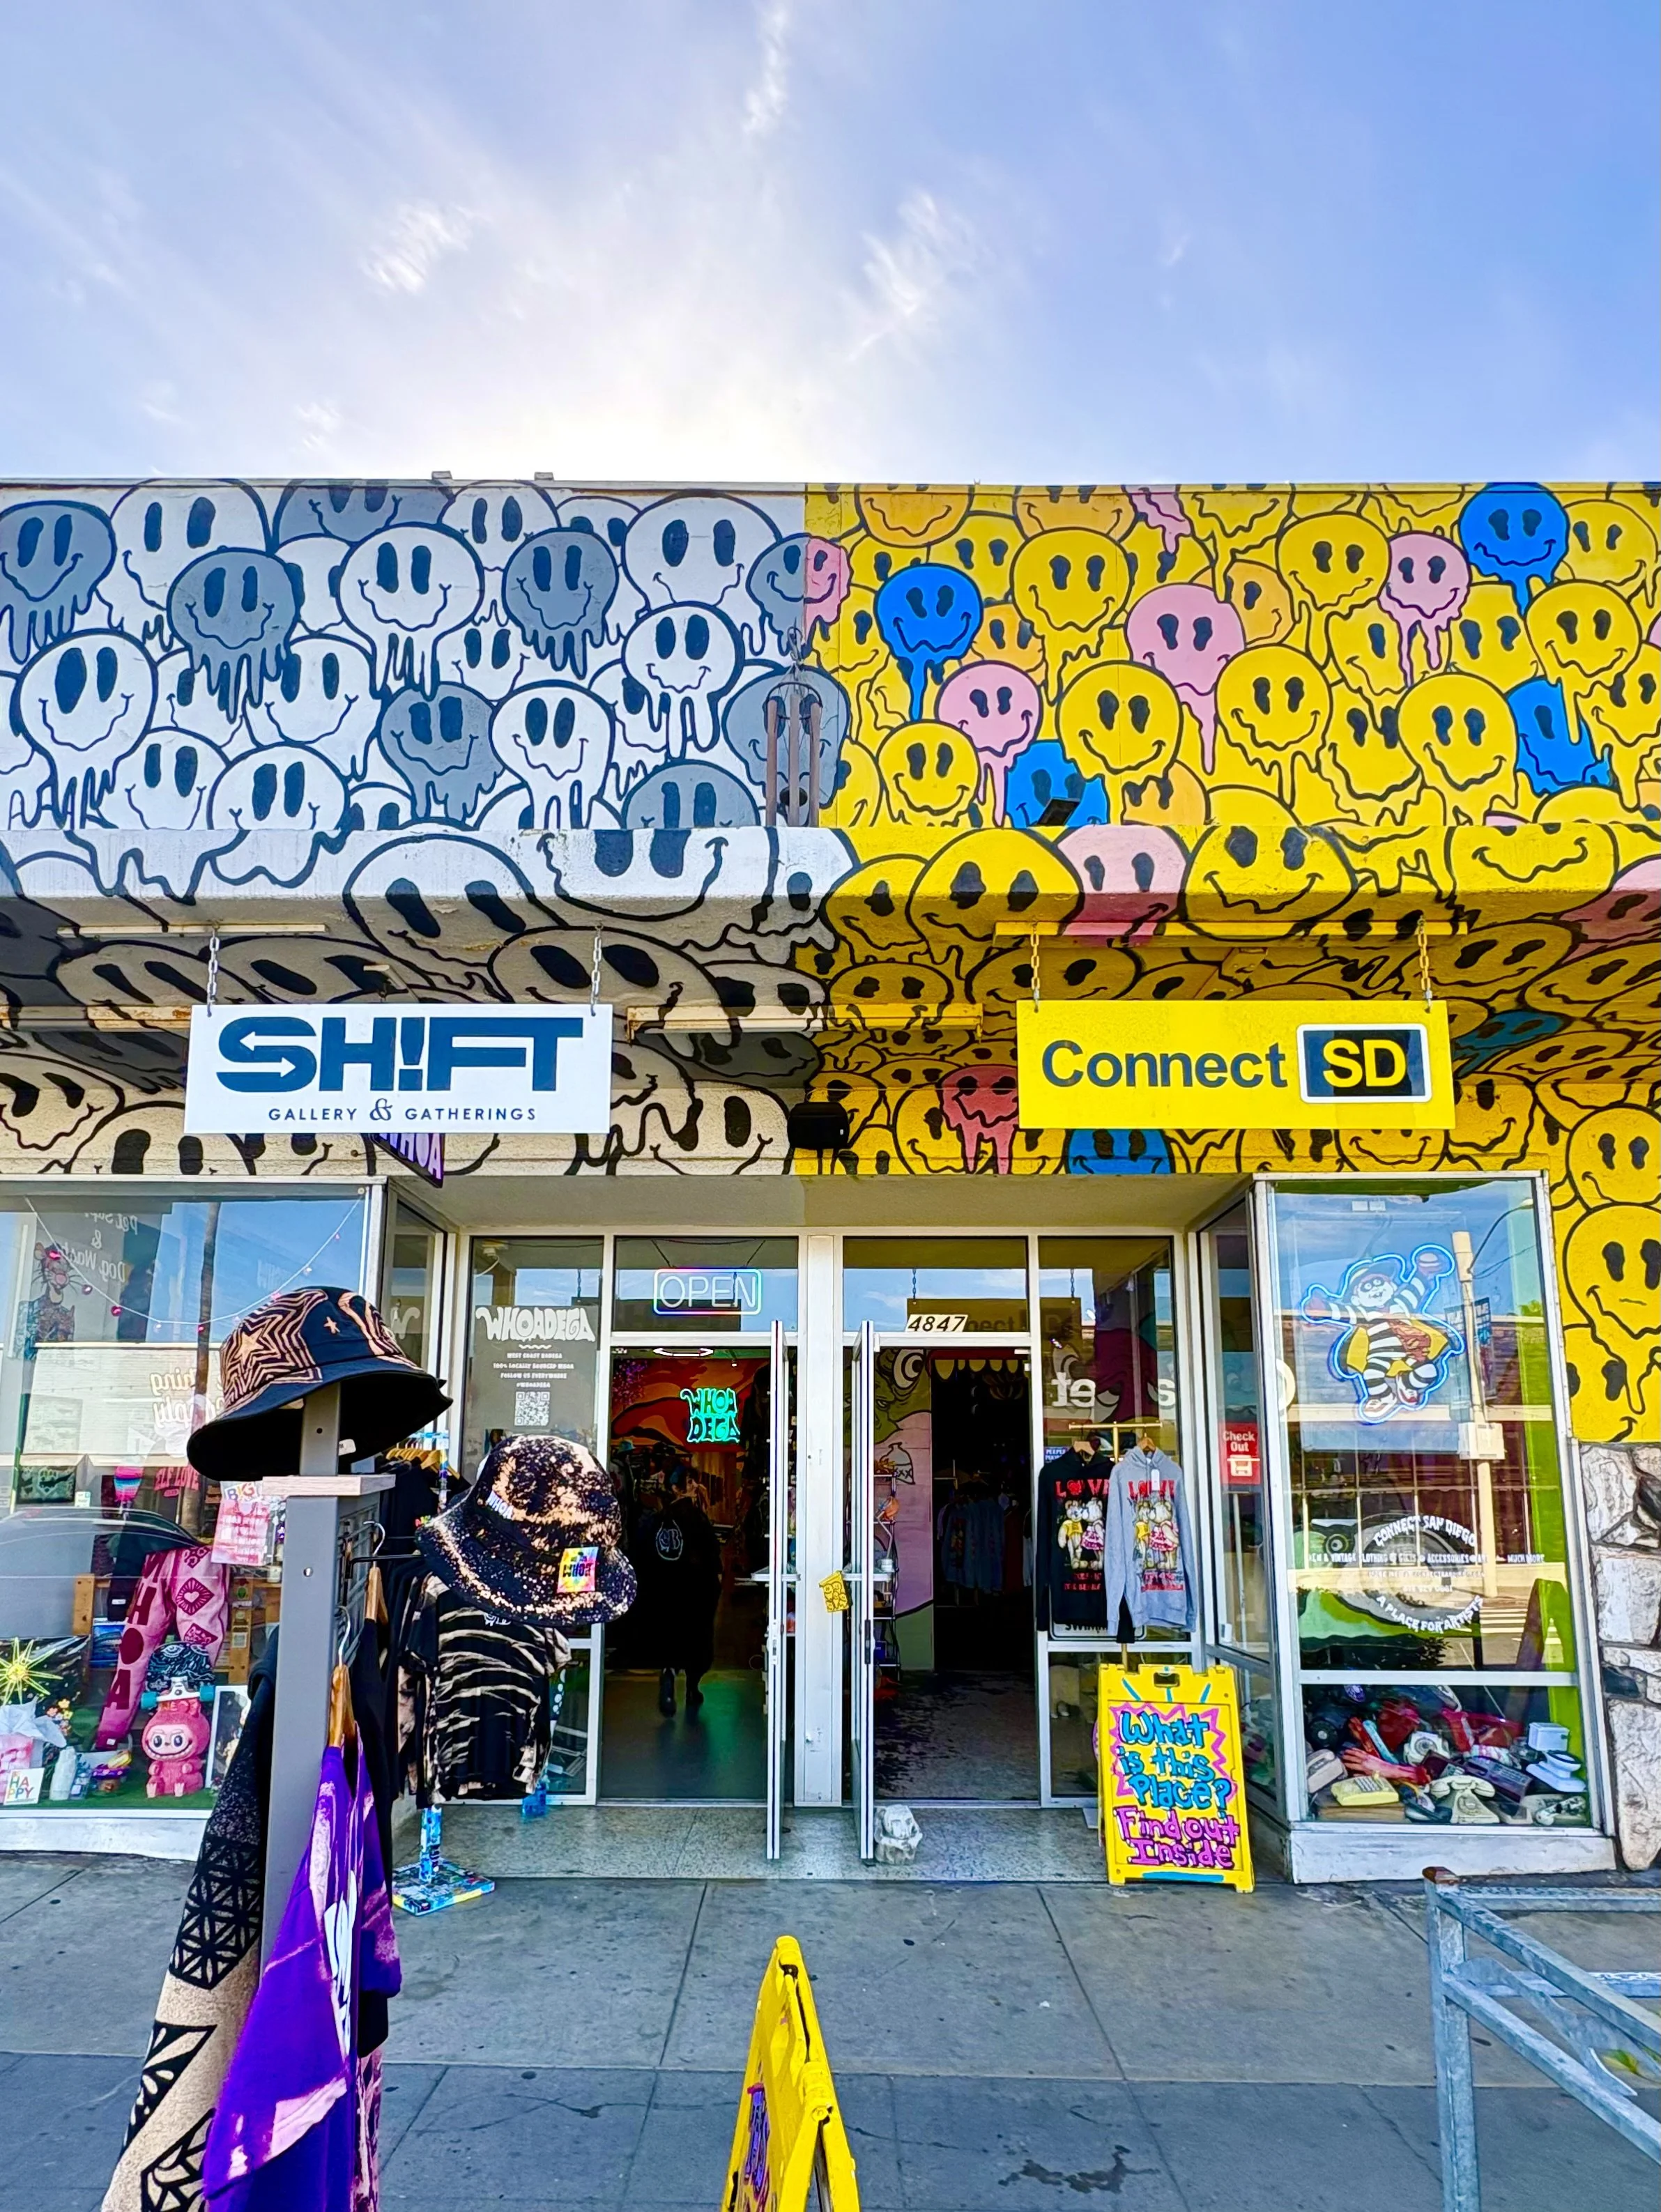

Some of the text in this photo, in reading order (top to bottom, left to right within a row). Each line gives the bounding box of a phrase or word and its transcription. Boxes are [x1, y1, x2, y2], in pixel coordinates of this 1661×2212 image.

[1042, 1039, 1407, 1088] Connect SD
[268, 1098, 536, 1121] GALLERY & GATHERINGS
[660, 1275, 756, 1308] OPEN
[475, 1307, 596, 1342] WHOADEGA
[908, 1316, 966, 1332] 4847
[680, 1388, 738, 1418] WHOA
[1223, 1431, 1255, 1442] Check
[1230, 1441, 1249, 1452] Out
[1373, 1516, 1477, 1546] CONNECT SAN DIEGO
[1427, 1553, 1469, 1563] ACCESSORIES
[1376, 1594, 1484, 1634] A PLACE FOR ARTISTS
[1118, 1710, 1209, 1749] What
[1117, 1744, 1216, 1782] is this
[1126, 1776, 1232, 1819] Place?
[1113, 1806, 1240, 1847] Find out
[1126, 1836, 1234, 1870] Inside
